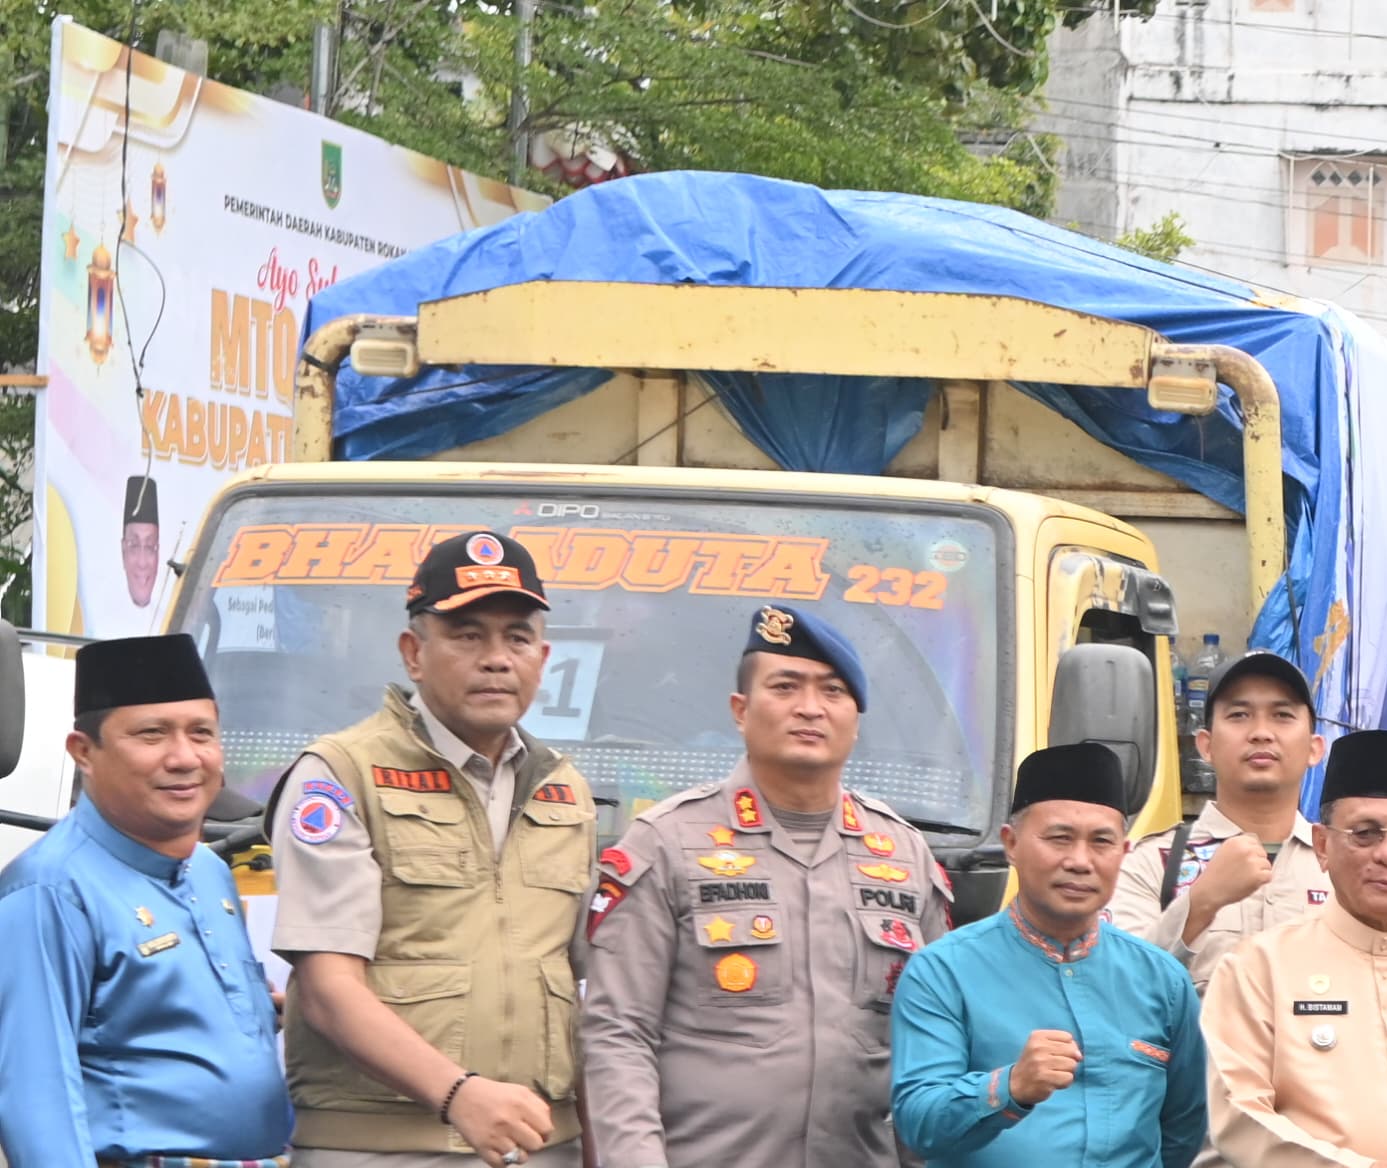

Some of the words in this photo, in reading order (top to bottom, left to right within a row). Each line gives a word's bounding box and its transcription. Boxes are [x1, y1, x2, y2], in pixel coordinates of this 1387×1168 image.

[224, 195, 283, 227] PEMERINTAH
[285, 214, 323, 238] DAERAH
[324, 226, 376, 254] KABUPATEN
[257, 246, 298, 312] Ayo
[537, 503, 600, 518] DIPO
[843, 565, 948, 609] 232
[540, 657, 582, 719] 1
[860, 887, 916, 914] POLRI
[1311, 891, 1328, 902] TA
